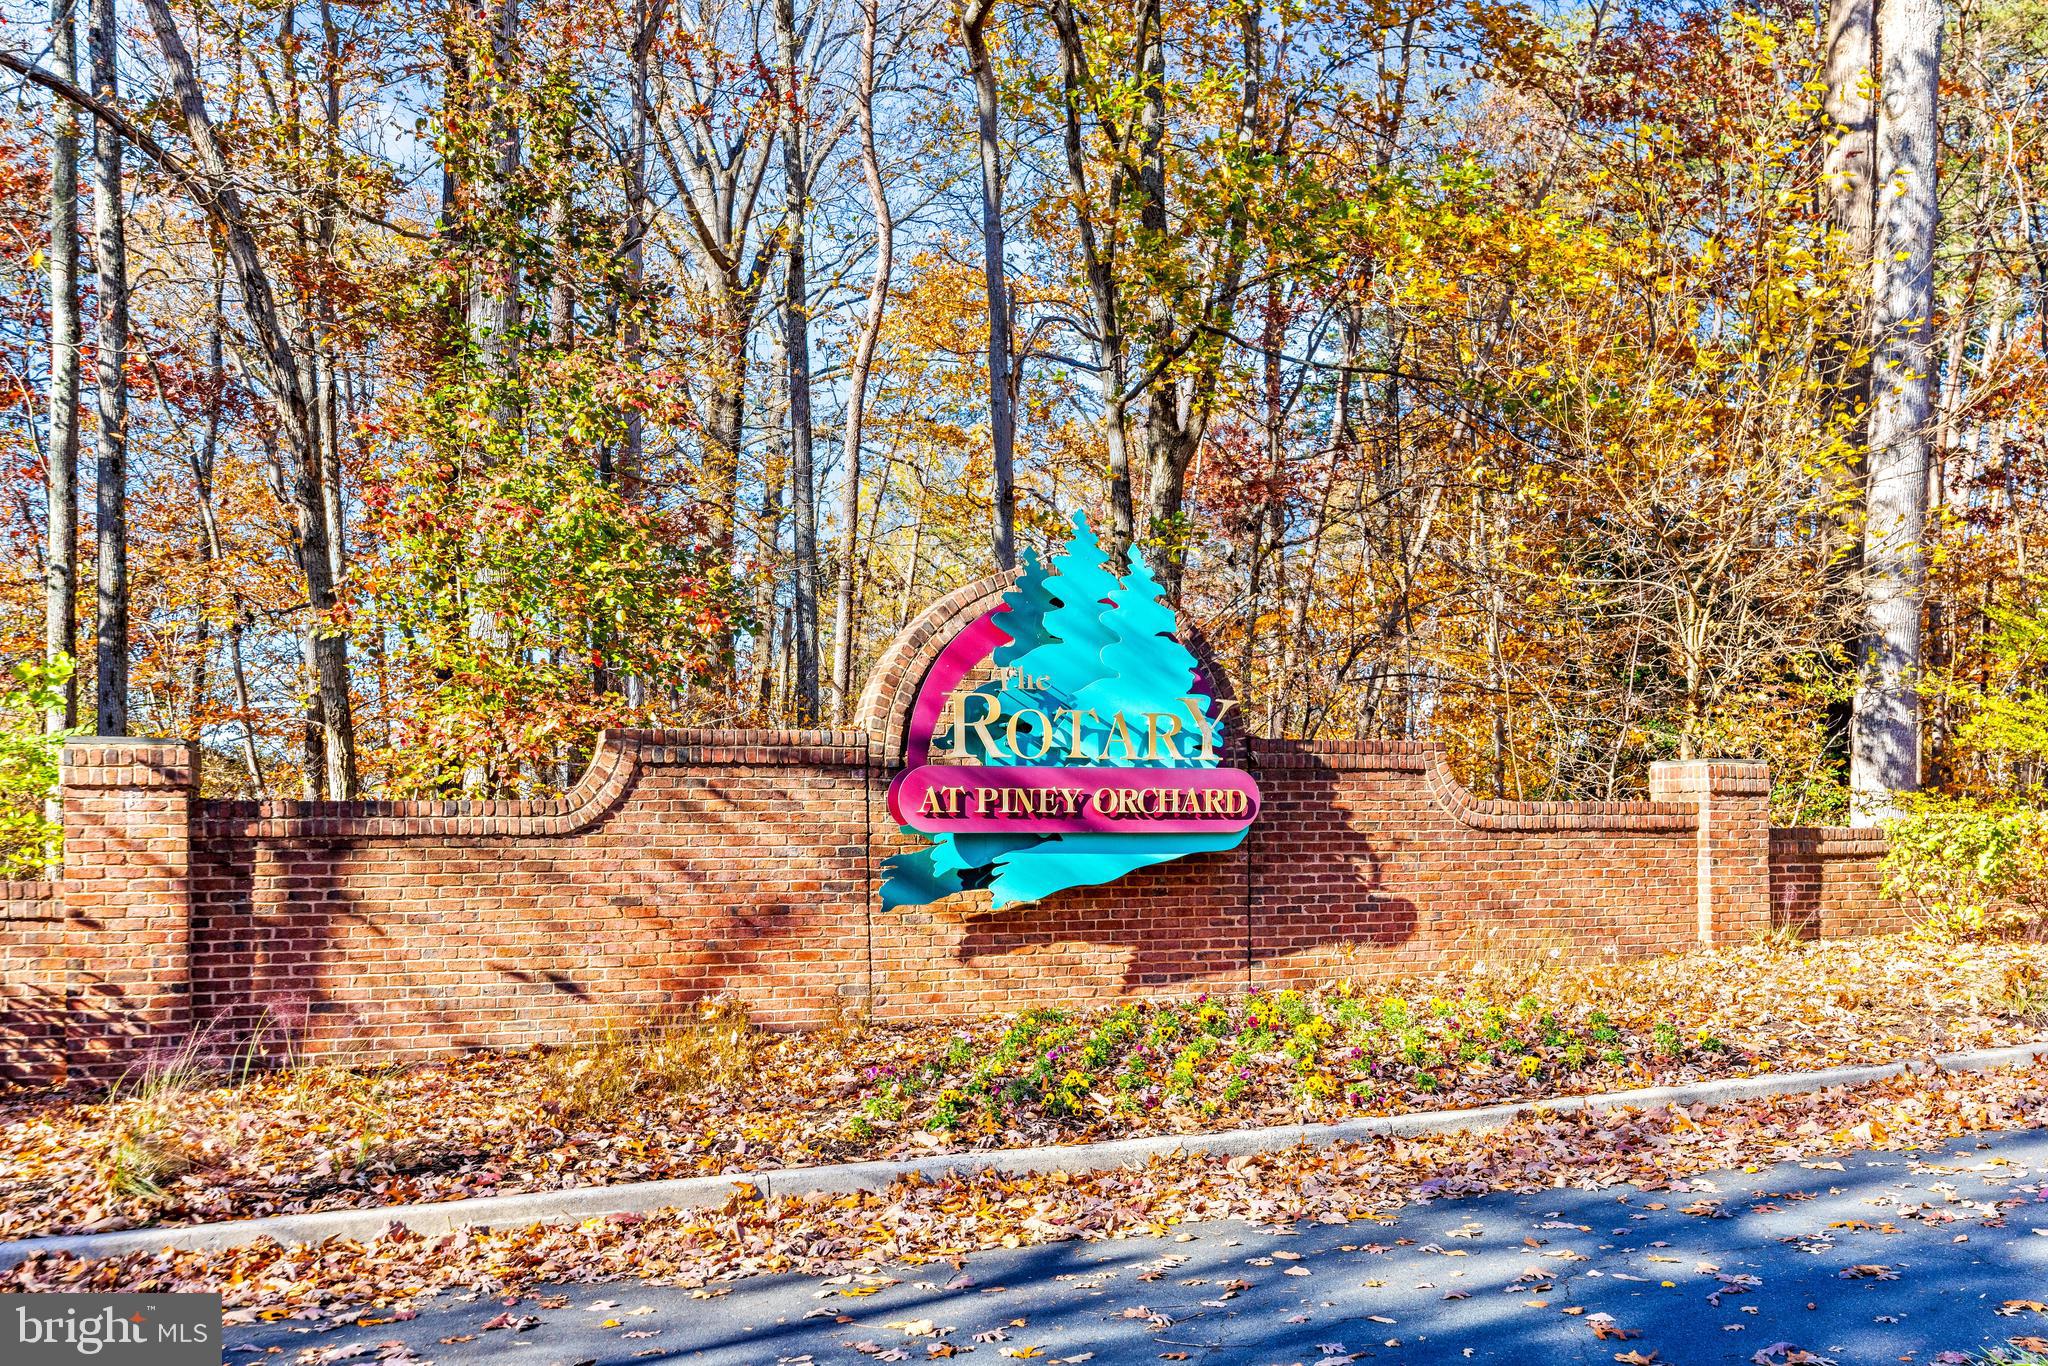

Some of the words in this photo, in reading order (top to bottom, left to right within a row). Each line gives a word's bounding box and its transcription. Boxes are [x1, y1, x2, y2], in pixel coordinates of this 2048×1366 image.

[997, 665, 1052, 692] The
[942, 692, 1239, 762] ROTARY
[916, 785, 962, 815] AT
[974, 785, 1083, 815] PINEY
[1093, 786, 1249, 816] ORCHARD
